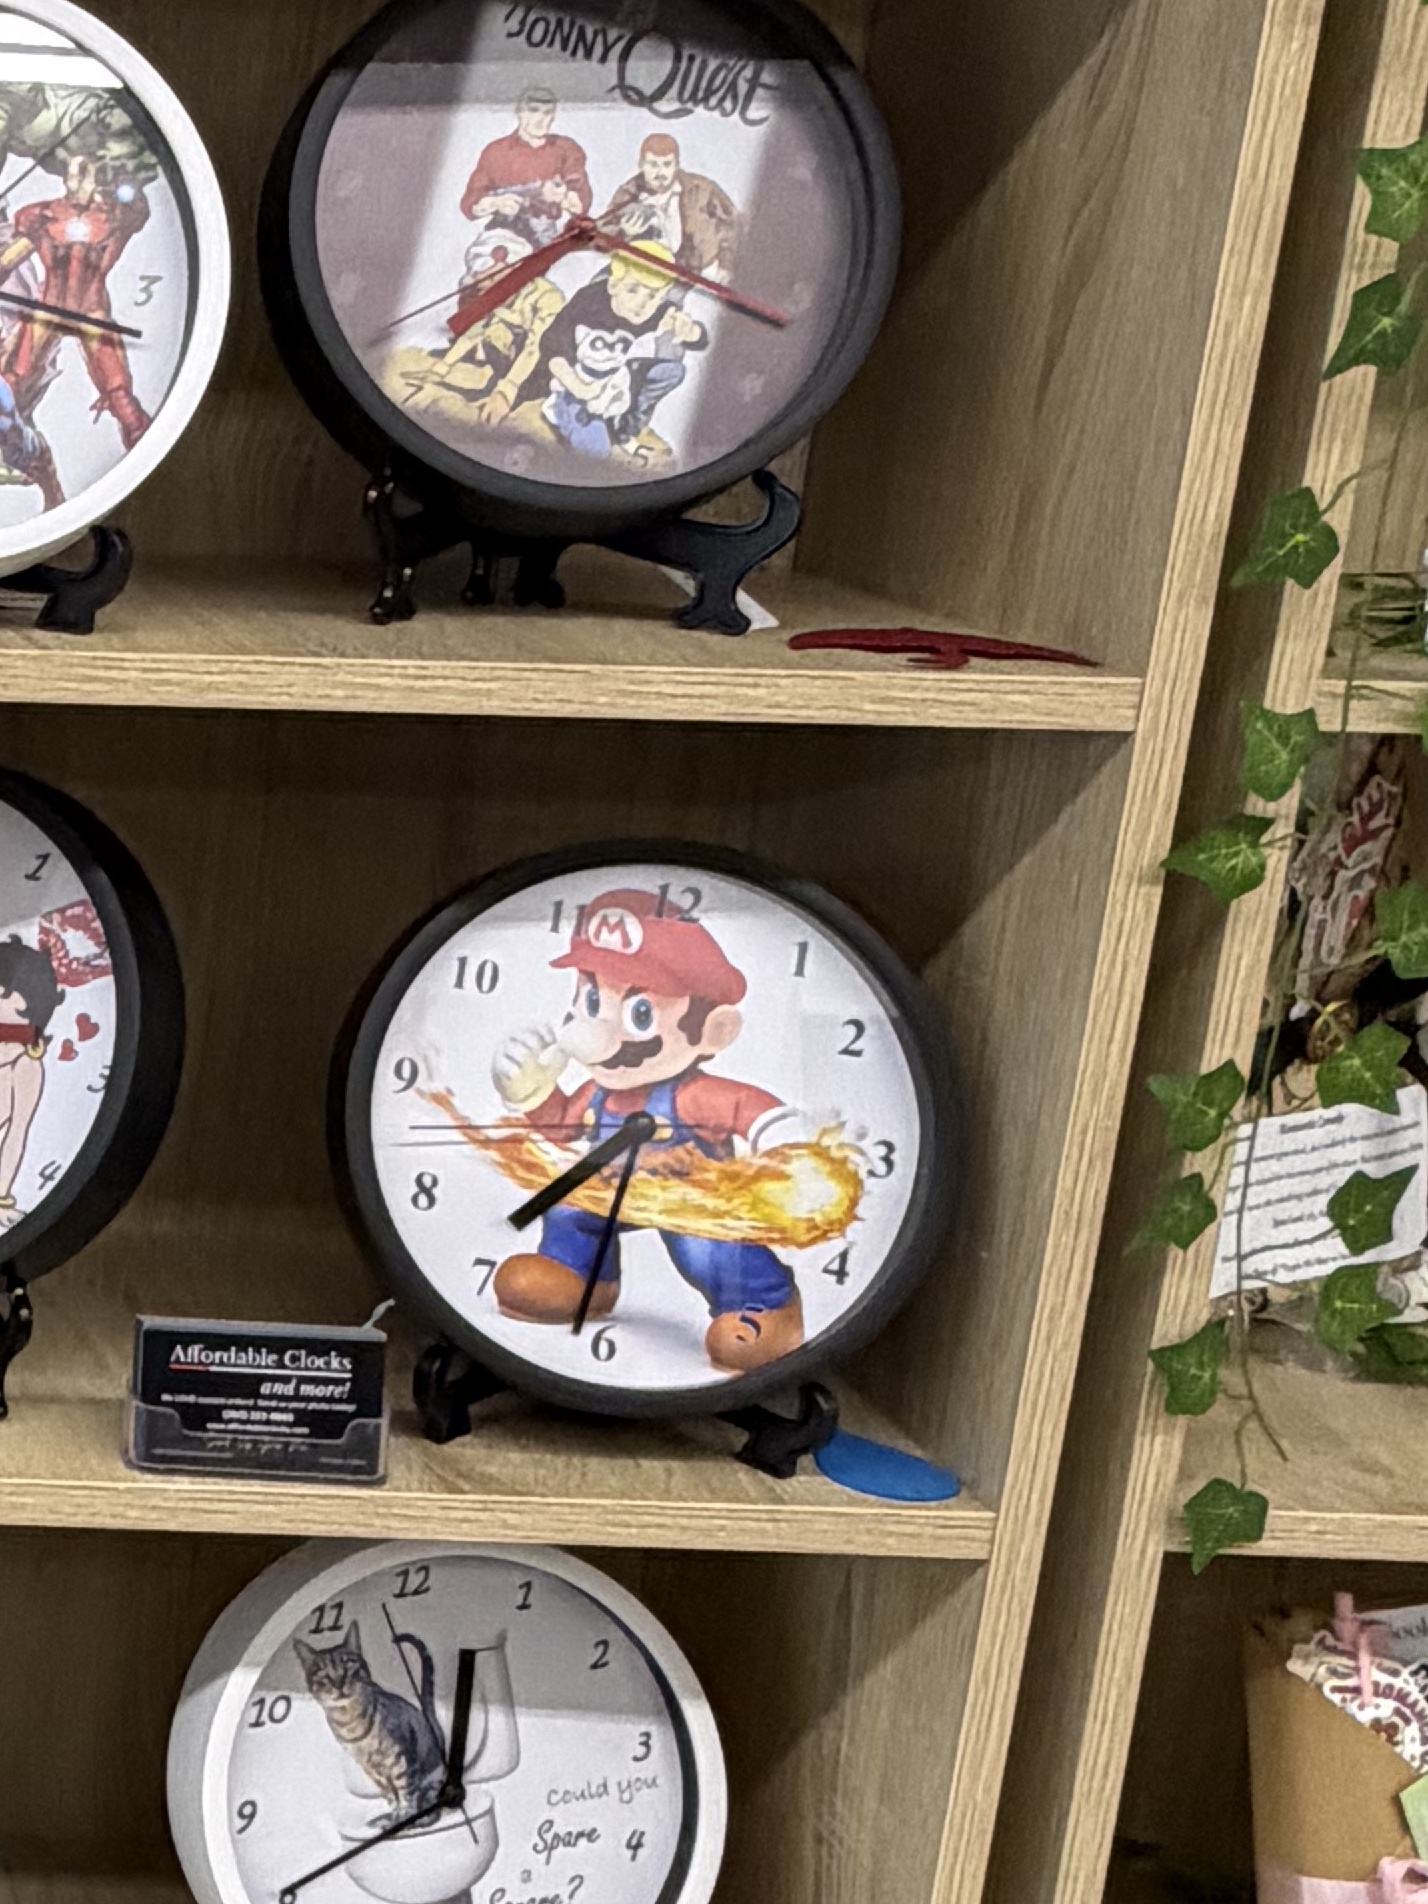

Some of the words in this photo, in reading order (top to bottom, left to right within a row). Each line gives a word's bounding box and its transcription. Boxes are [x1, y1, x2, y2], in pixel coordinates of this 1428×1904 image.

[505, 5, 625, 65] JONNY
[607, 29, 780, 127] Quest
[452, 956, 501, 994] 10
[837, 1019, 867, 1056] 2
[393, 1057, 420, 1093] 9
[410, 1173, 439, 1210] 8
[822, 1246, 852, 1285] 4
[170, 1345, 278, 1366] Affordable
[284, 1350, 352, 1370] Clocks
[591, 1327, 618, 1363] 6
[260, 1379, 296, 1396] and
[300, 1381, 351, 1399] more!
[393, 1566, 432, 1598] 12
[515, 1581, 533, 1611] 1
[308, 1602, 346, 1634] 11
[589, 1641, 611, 1670] 2
[248, 1695, 292, 1728] 10
[632, 1732, 653, 1761] 3
[547, 1777, 609, 1807] could
[617, 1774, 659, 1804] you
[236, 1800, 258, 1833] 9
[532, 1819, 601, 1865] Spare
[624, 1828, 645, 1861] 4
